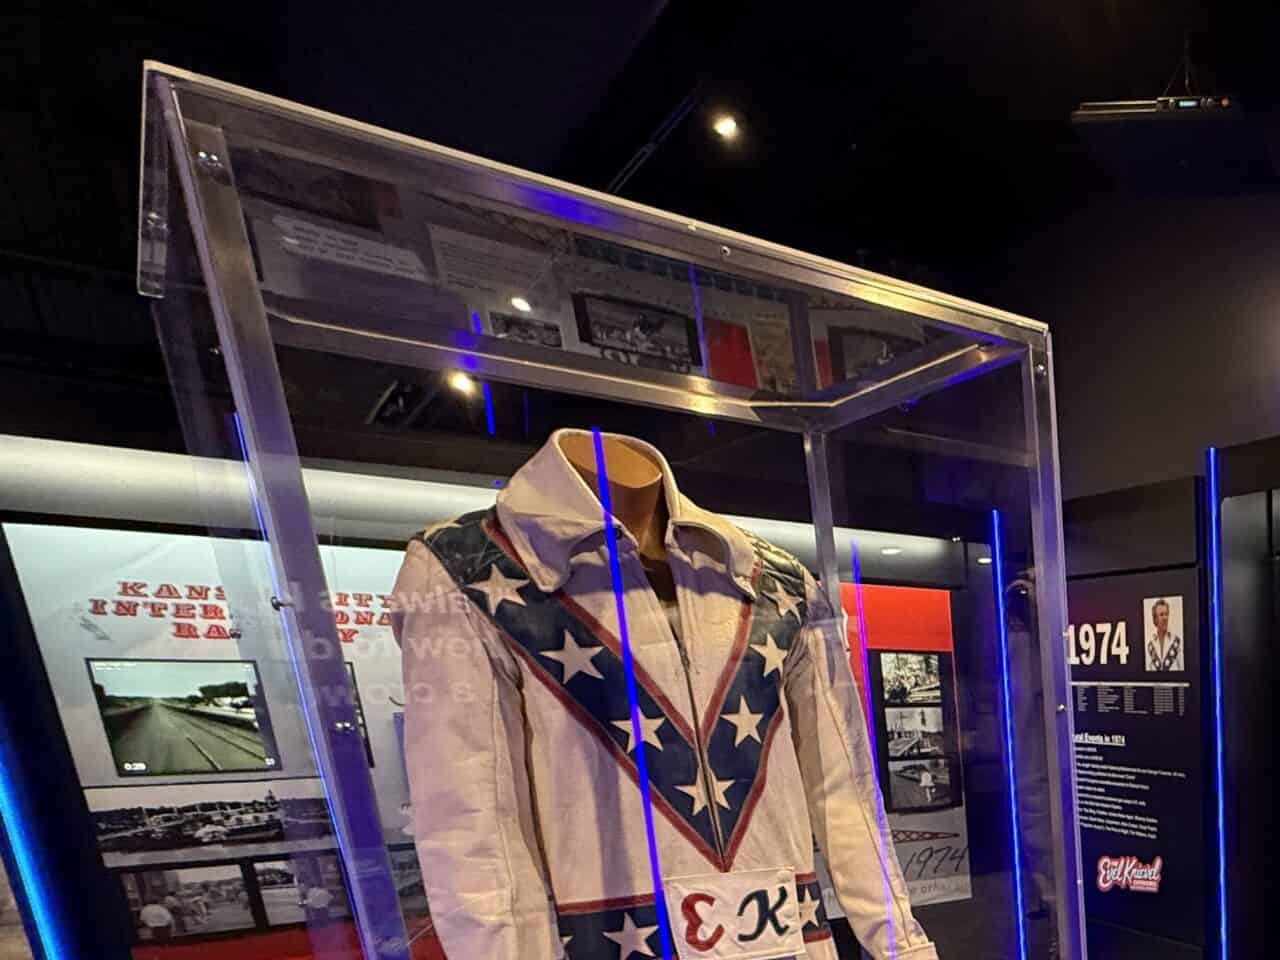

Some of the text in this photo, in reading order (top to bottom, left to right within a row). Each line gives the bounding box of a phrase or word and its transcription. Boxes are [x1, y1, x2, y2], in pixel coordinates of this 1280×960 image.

[118, 581, 226, 600] KANS
[1067, 621, 1130, 665] 1974
[904, 846, 968, 878] 1974
